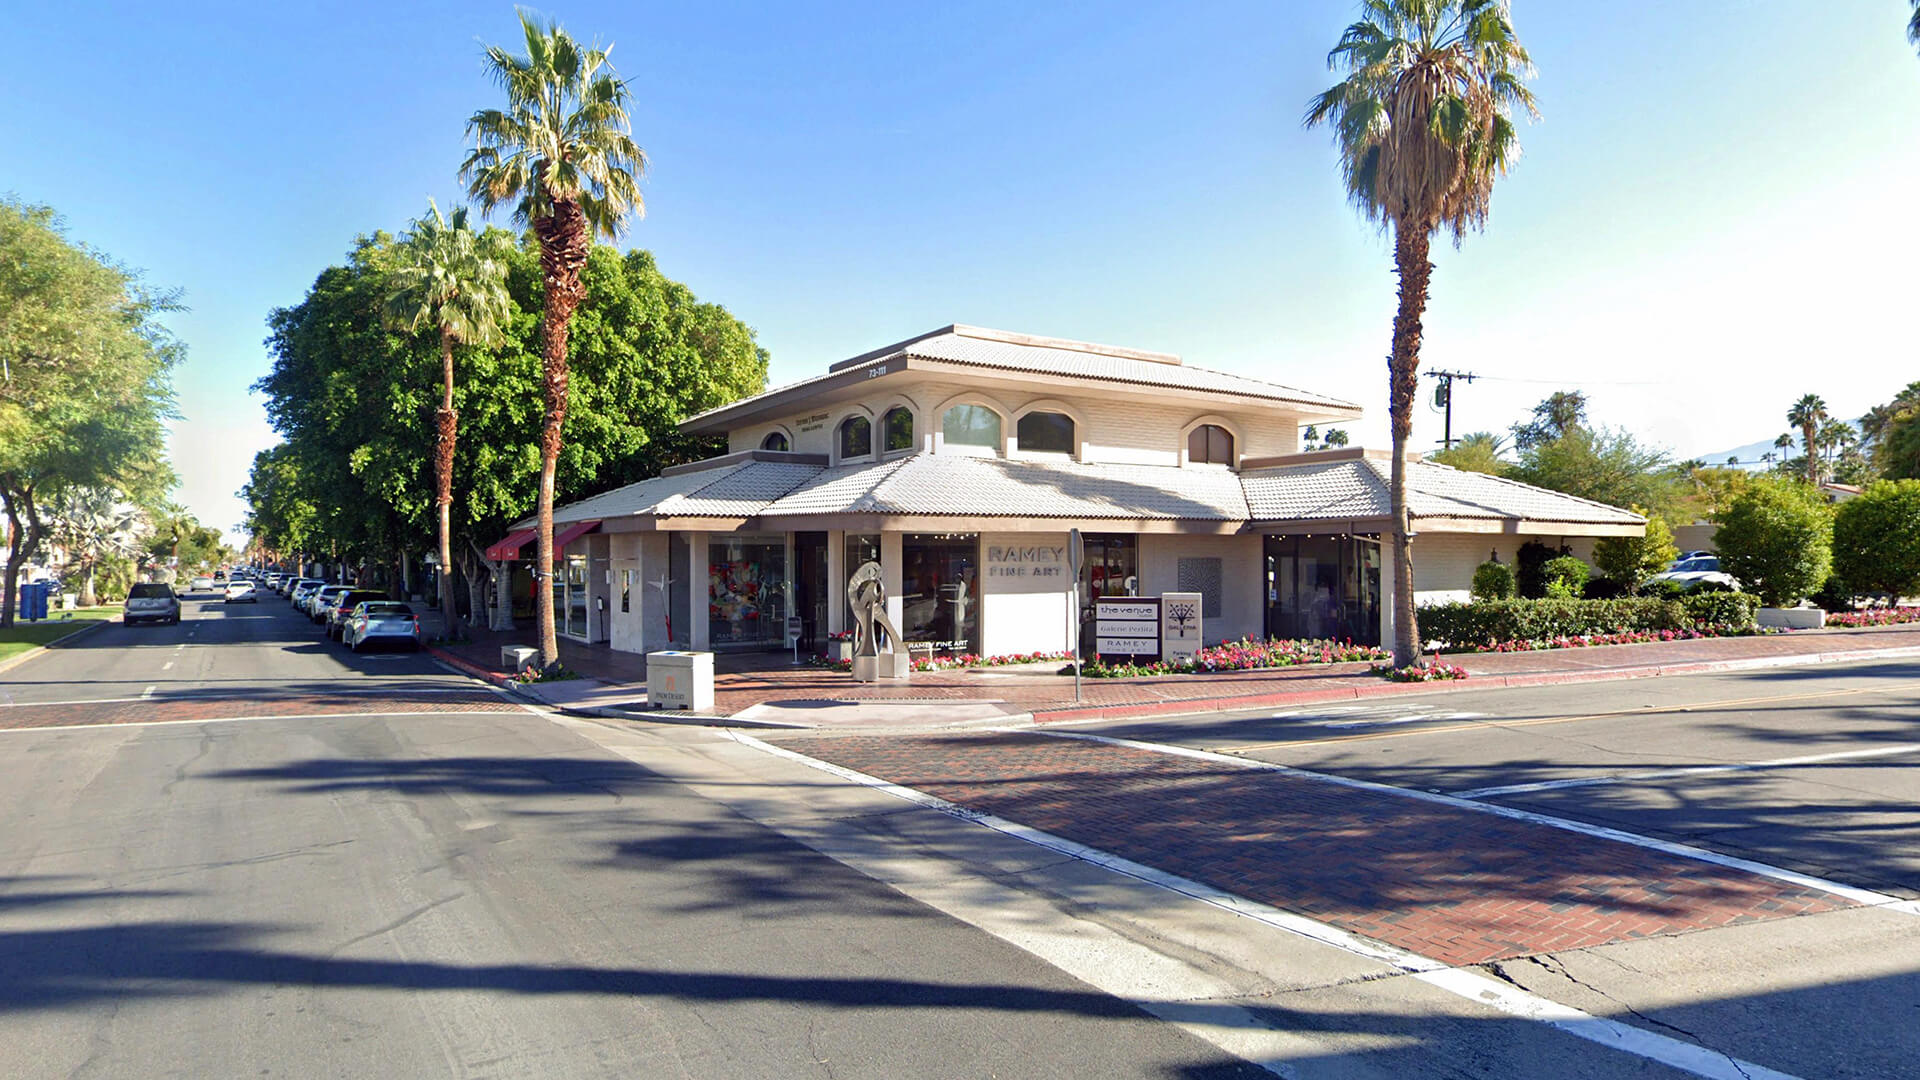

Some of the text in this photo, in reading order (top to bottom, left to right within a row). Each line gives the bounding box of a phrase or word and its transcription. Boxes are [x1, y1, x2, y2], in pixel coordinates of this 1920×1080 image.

[869, 366, 886, 378] 73-111
[988, 546, 1064, 562] RAMEY
[989, 567, 1061, 576] FINE ART
[1101, 605, 1119, 615] the
[1120, 607, 1152, 616] venue
